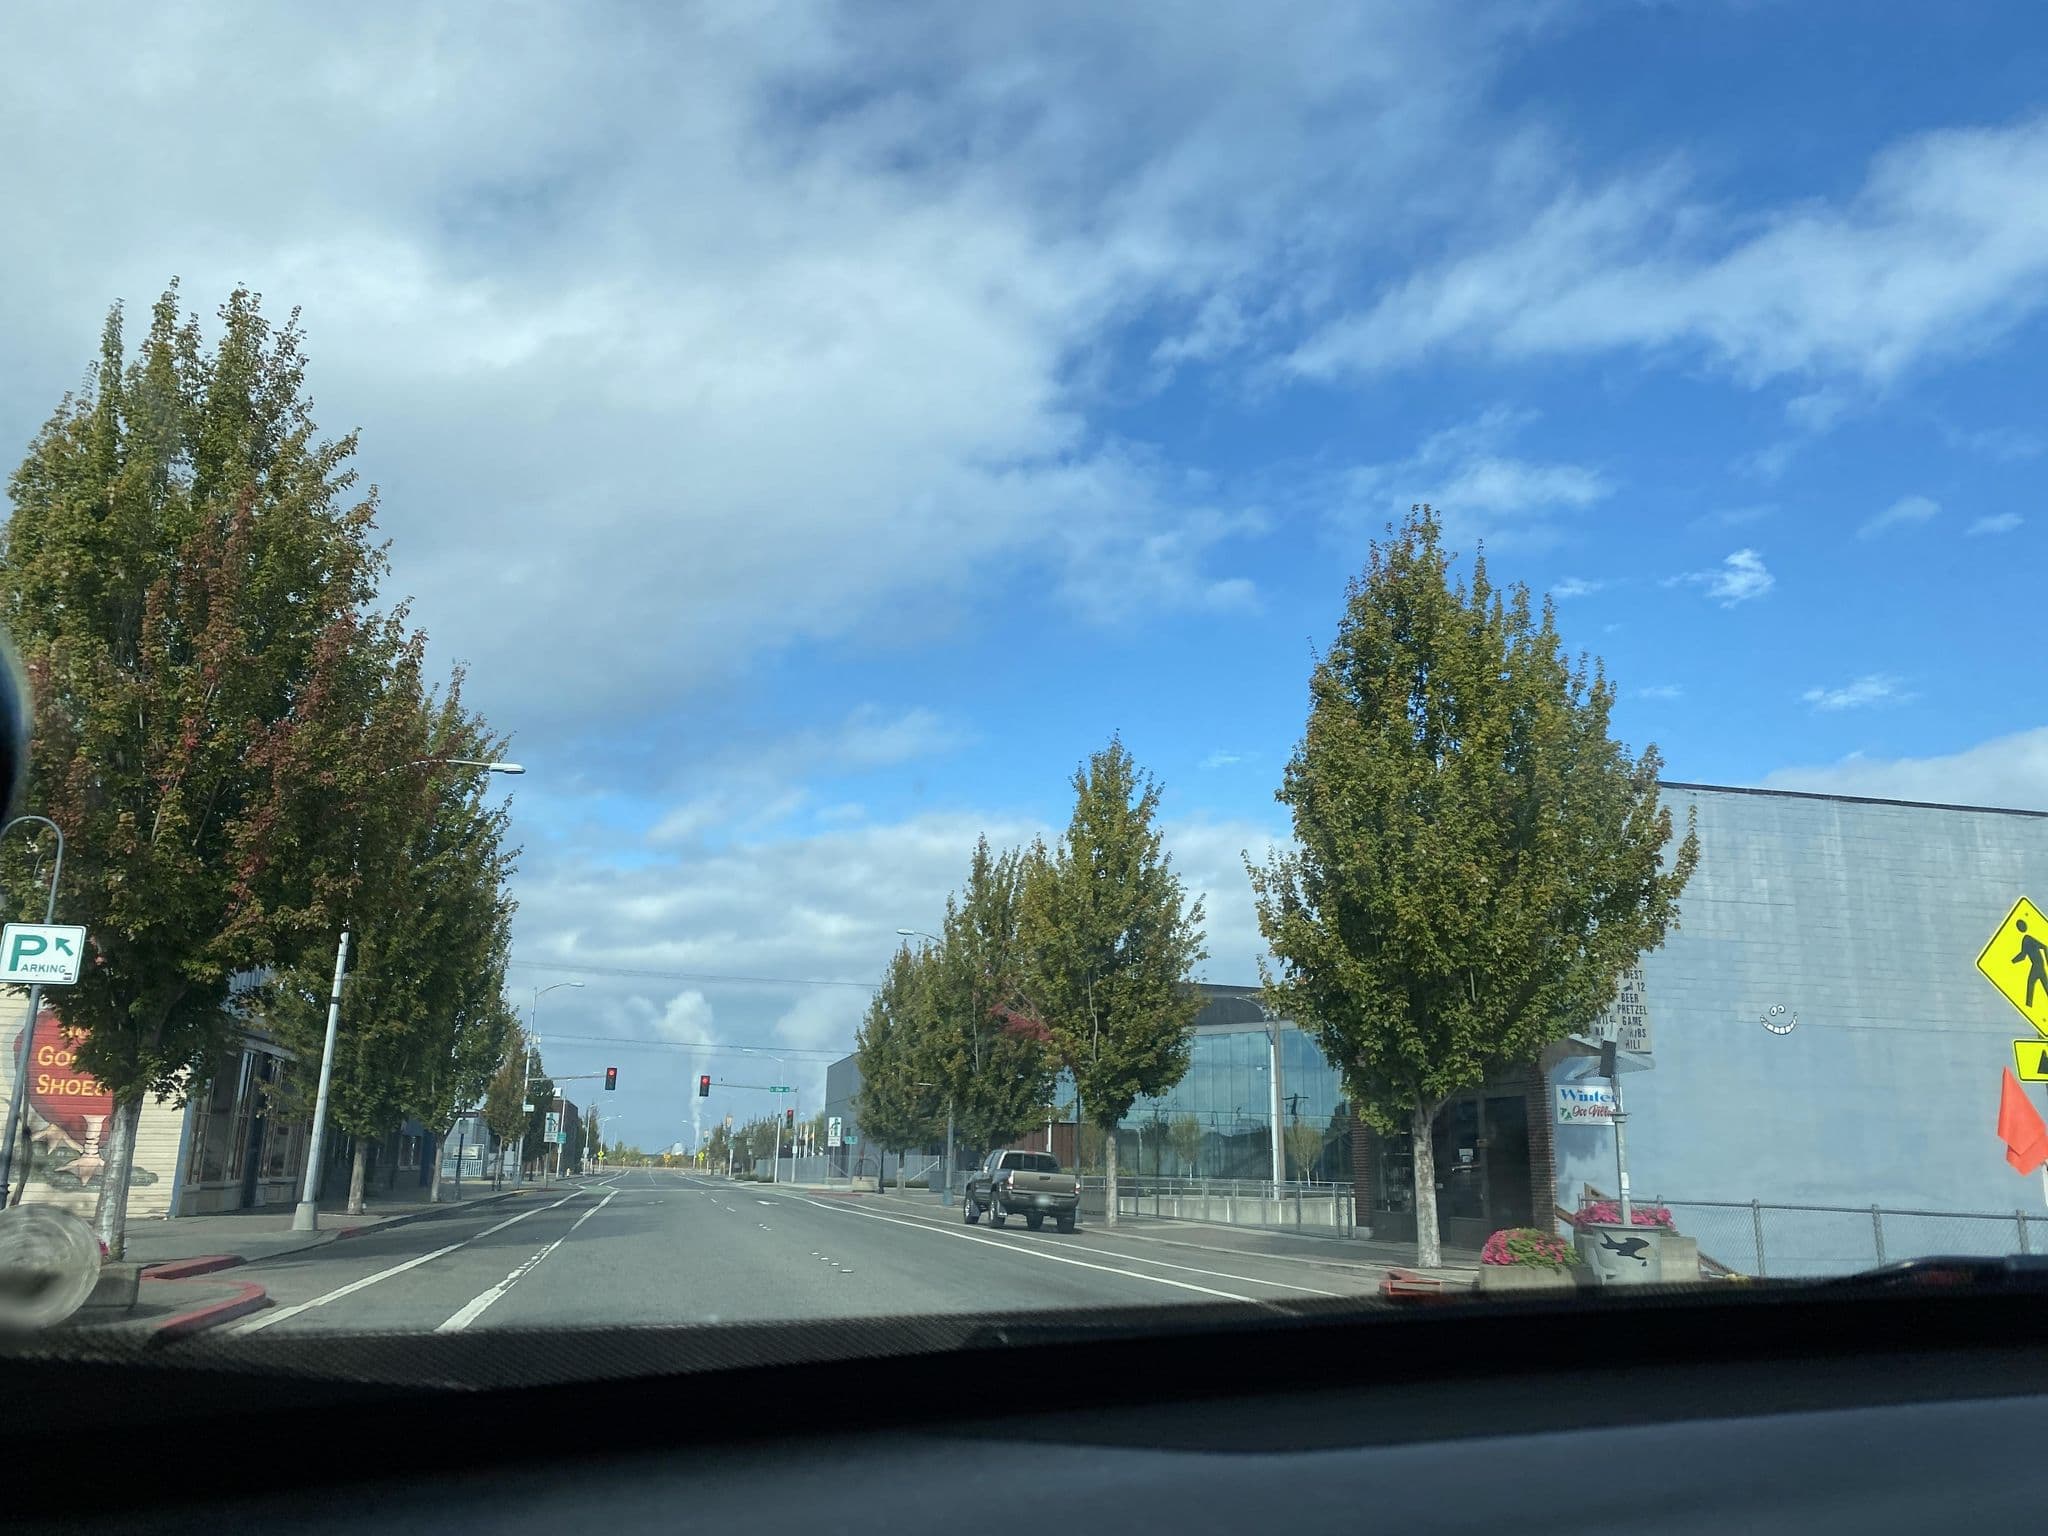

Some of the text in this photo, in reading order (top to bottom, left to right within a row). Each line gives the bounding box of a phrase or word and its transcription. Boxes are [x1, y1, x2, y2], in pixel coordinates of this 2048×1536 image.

[1621, 993, 1639, 1003] BEER
[1617, 1004, 1648, 1015] PRETZEL
[1623, 1016, 1642, 1026] GAME
